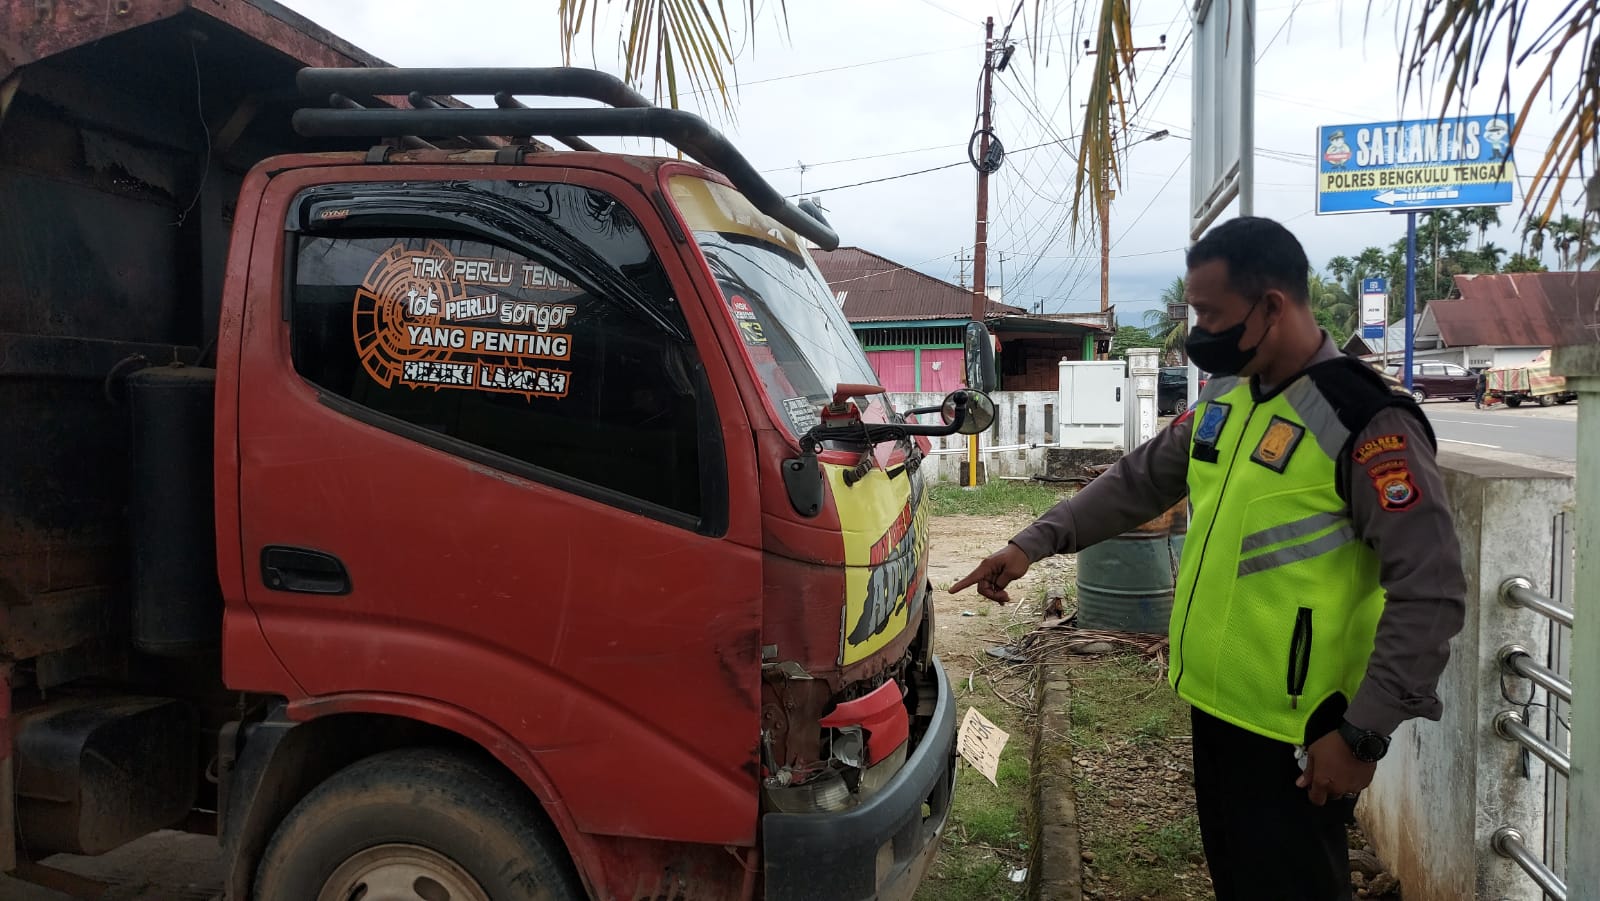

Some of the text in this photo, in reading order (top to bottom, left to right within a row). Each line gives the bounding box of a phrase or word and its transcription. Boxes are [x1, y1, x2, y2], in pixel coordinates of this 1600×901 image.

[1356, 120, 1480, 167] SATLANTAS
[1327, 172, 1375, 189] POLRES
[1380, 168, 1449, 186] BENGKULU
[411, 256, 445, 279] TAK
[452, 260, 513, 283] PERLU
[445, 294, 497, 321] PERLU
[408, 325, 568, 356] YANG PENTING
[404, 361, 474, 385] REZEKI
[1358, 436, 1399, 456] POLRES
